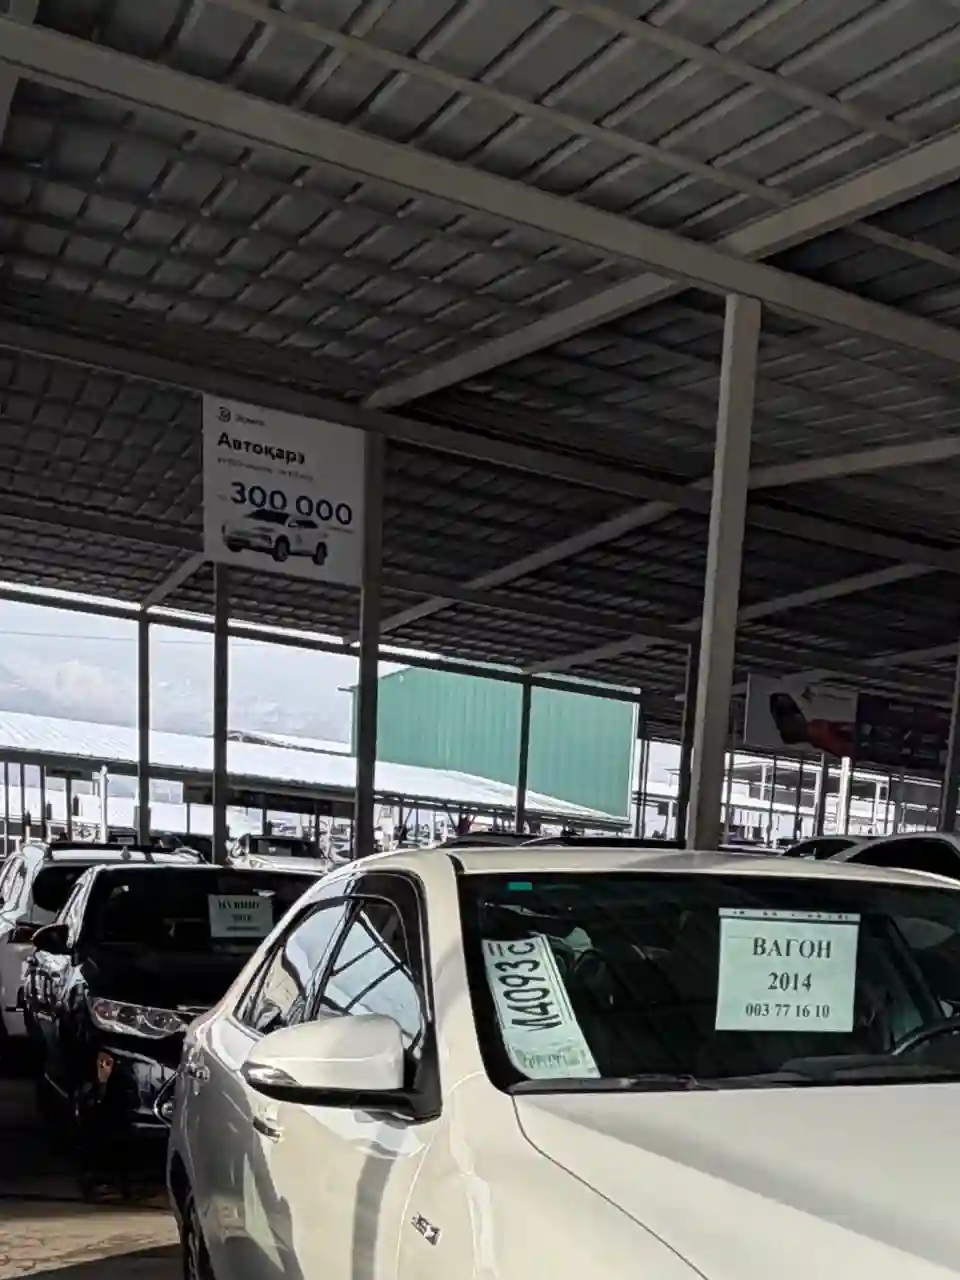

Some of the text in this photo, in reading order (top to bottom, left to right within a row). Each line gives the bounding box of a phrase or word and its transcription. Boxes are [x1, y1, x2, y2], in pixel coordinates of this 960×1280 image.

[231, 481, 353, 525] 300 000
[752, 937, 833, 960] ВАГОН
[767, 972, 813, 992] 2014
